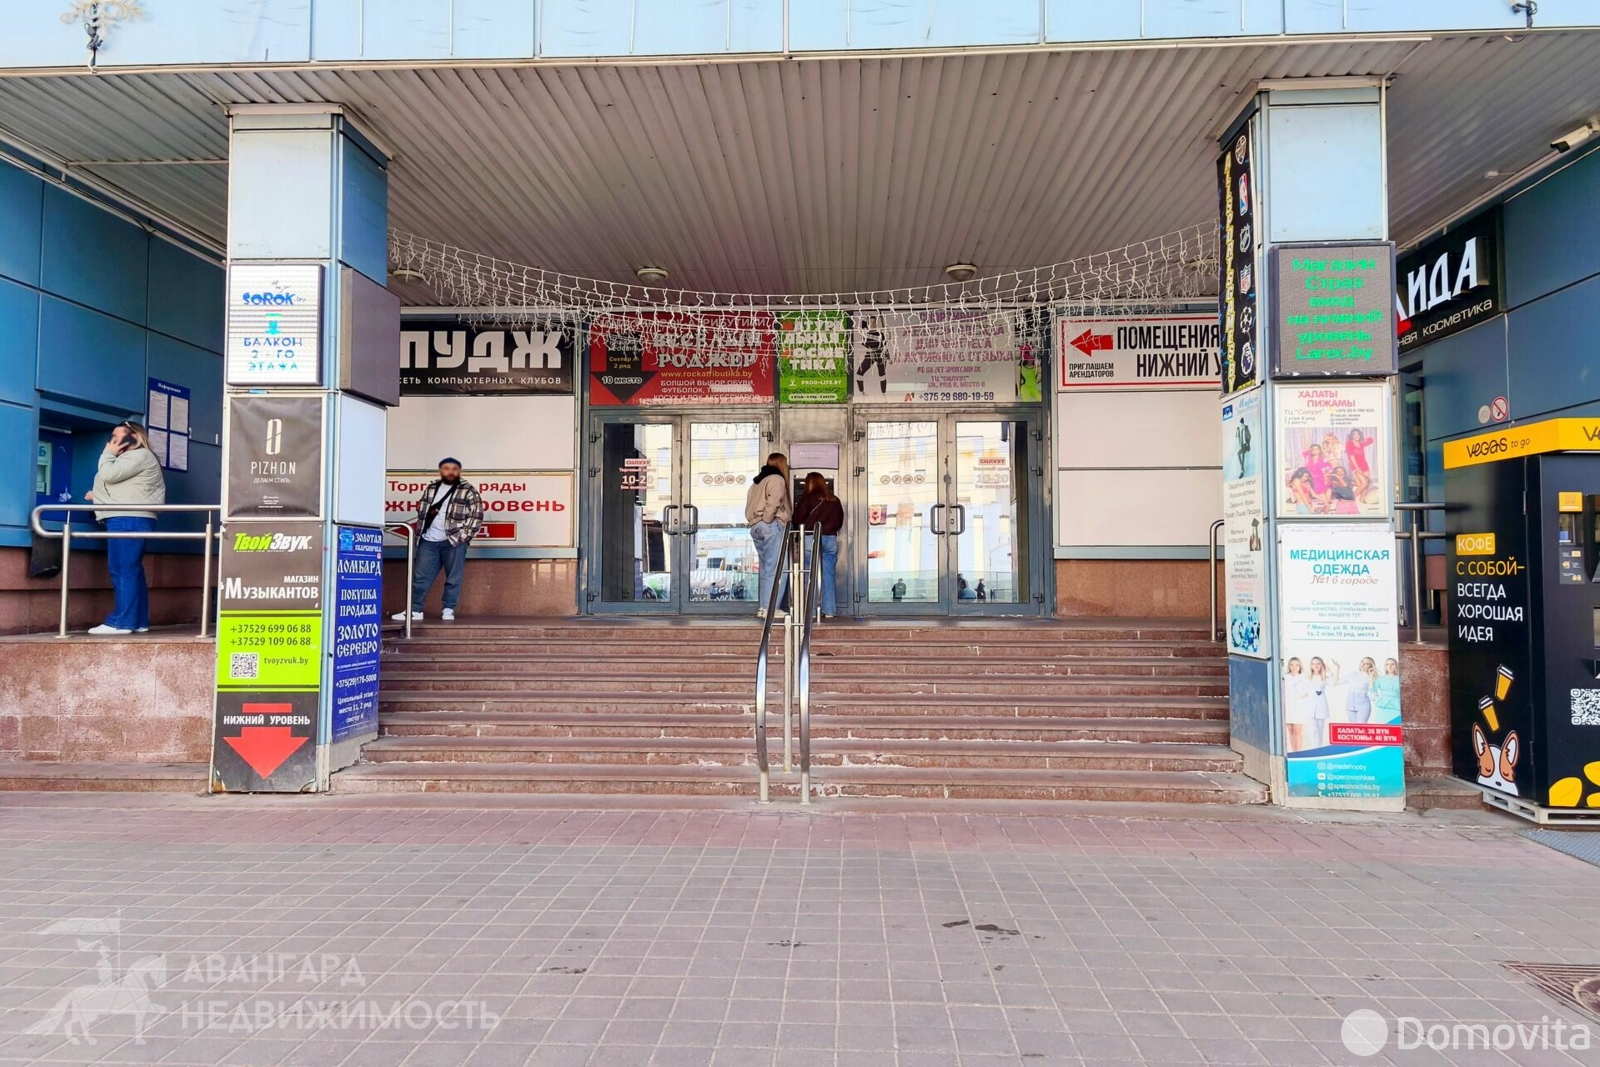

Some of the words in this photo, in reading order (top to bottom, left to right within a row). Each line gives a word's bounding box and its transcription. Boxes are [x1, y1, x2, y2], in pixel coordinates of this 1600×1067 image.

[1292, 258, 1376, 271] Магазин
[1397, 237, 1478, 321] ИДА
[242, 292, 295, 305] SOROK
[1288, 314, 1310, 325] на
[1422, 299, 1493, 337] косметика
[243, 337, 303, 346] БАЛКОН
[1117, 325, 1220, 351] ПОМЕЩЕНИЯ
[1297, 331, 1372, 344] уровень
[658, 353, 758, 369] РОДЖЕР
[1137, 349, 1209, 377] НИЖНИЙ
[602, 376, 613, 384] 10
[1069, 370, 1114, 378] АРЕНДАТОРОВ
[1298, 390, 1338, 398] ХАЛАТЫ
[1307, 399, 1356, 408] ПИЖАМЫ
[1511, 440, 1518, 448] to
[1520, 438, 1530, 449] go
[250, 461, 296, 475] PIZHON
[479, 482, 526, 493] ряды
[482, 500, 566, 514] ровень
[355, 533, 382, 544] ЗОЛОТАЯ
[1457, 537, 1493, 551] КОФЕ
[1290, 549, 1390, 561] МЕДИЦИНСКАЯ
[337, 559, 382, 577] ЛОМБАРД
[1313, 564, 1370, 576] ОДЕЖДА
[1456, 562, 1465, 575] С
[284, 575, 319, 583] МАГАЗИН
[1340, 576, 1379, 585] городе
[341, 588, 377, 603] ПОКУПКА
[1457, 583, 1506, 600] ВСЕГДА
[339, 604, 377, 617] ПРОДАЖА
[1457, 604, 1523, 622] ХОРОШАЯ
[230, 625, 266, 633] +37529
[268, 625, 285, 633] 699
[287, 625, 298, 633] 06
[300, 625, 312, 633] 88
[337, 623, 379, 643] ЗОЛОТО
[1458, 625, 1494, 642] ИДЕЯ
[230, 638, 265, 646] +37529
[268, 638, 284, 646] 109
[286, 637, 298, 646] 06
[300, 637, 311, 646] 88
[337, 641, 378, 658] СЕРЕБРО
[264, 657, 309, 666] tvoyzvuk.by
[223, 714, 264, 725] НИЖНИЙ
[269, 715, 311, 725] УРОВЕНЬ
